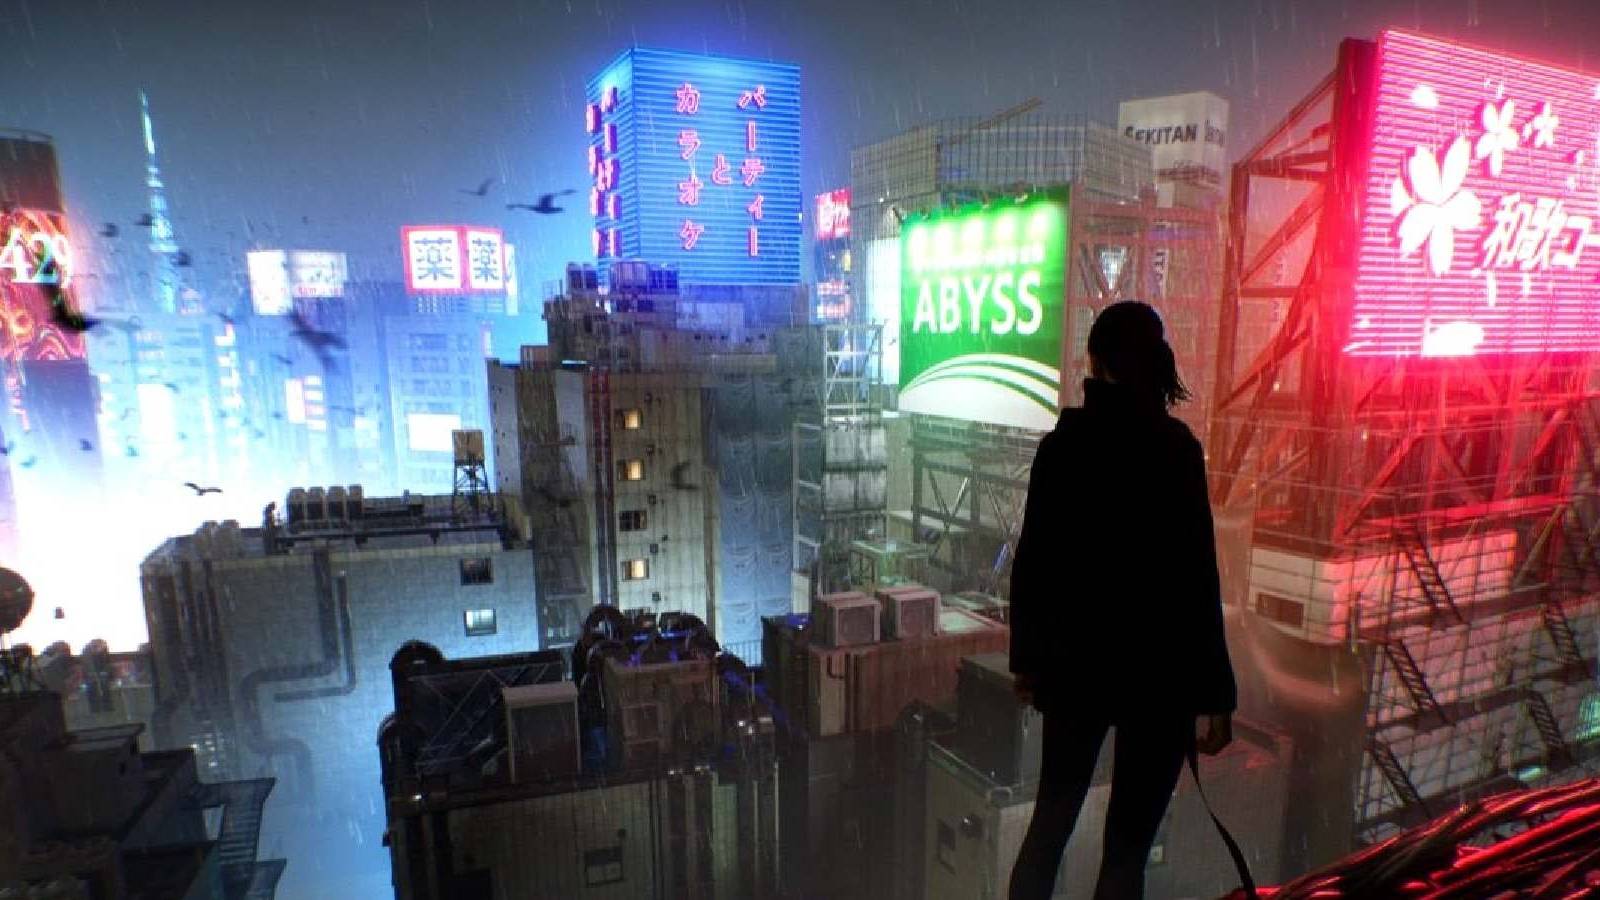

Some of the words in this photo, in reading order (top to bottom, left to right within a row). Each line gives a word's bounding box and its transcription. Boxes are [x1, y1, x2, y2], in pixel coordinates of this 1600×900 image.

[676, 83, 704, 250] カラオケ
[711, 153, 732, 185] と
[737, 84, 766, 257] パーティー
[414, 237, 454, 281] 薬
[472, 238, 499, 283] 薬
[912, 269, 1043, 336] ABYSS
